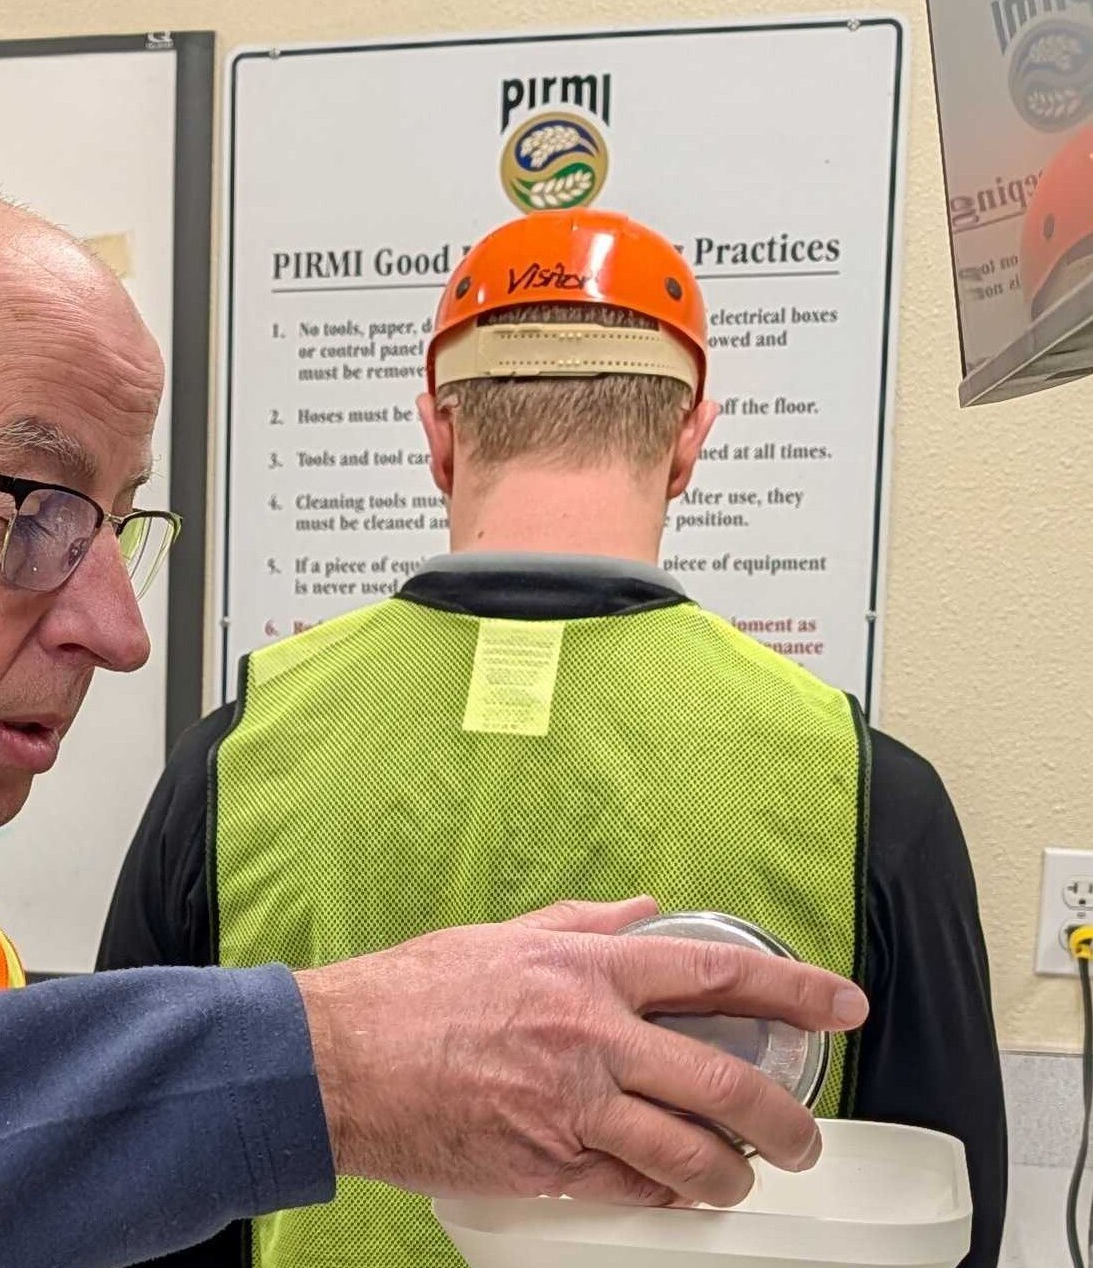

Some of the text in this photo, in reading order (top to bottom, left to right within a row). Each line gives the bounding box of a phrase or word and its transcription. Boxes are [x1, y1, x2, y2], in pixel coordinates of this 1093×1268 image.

[272, 250, 363, 279] PIRMI
[375, 244, 450, 277] Good
[694, 233, 840, 266] Practices
[272, 323, 286, 339] 1.
[299, 322, 319, 337] No
[323, 320, 365, 337] tools,
[710, 307, 786, 326] electrical
[791, 307, 839, 324] boxes
[298, 347, 315, 359] or
[319, 341, 375, 358] control
[708, 331, 751, 348] owed
[756, 330, 788, 347] and
[298, 364, 424, 381] must be remove
[269, 409, 284, 425] 2.
[297, 408, 343, 425] Hoses
[348, 408, 388, 423] must
[393, 406, 413, 422] be
[742, 398, 769, 415] the
[774, 397, 819, 415] floor.
[268, 443, 833, 469] 3. Tools and tool car ned at all times.
[267, 495, 283, 511] 4.
[295, 493, 366, 513] Cleaning
[369, 493, 407, 509] tools
[412, 495, 447, 508] mus
[680, 487, 723, 505] After
[767, 487, 805, 508] they
[295, 516, 335, 531] must
[340, 515, 359, 530] be
[363, 513, 425, 530] cleaned
[430, 517, 450, 530] an
[675, 510, 749, 531] position.
[266, 558, 282, 574] 5.
[295, 556, 310, 574] If
[311, 561, 321, 574] a
[324, 557, 367, 577] piece
[371, 555, 388, 573] of
[663, 555, 707, 571] piece
[712, 553, 730, 571] of
[733, 554, 827, 576] equipment
[294, 580, 308, 595] is
[312, 583, 357, 595] never
[797, 619, 817, 632] as
